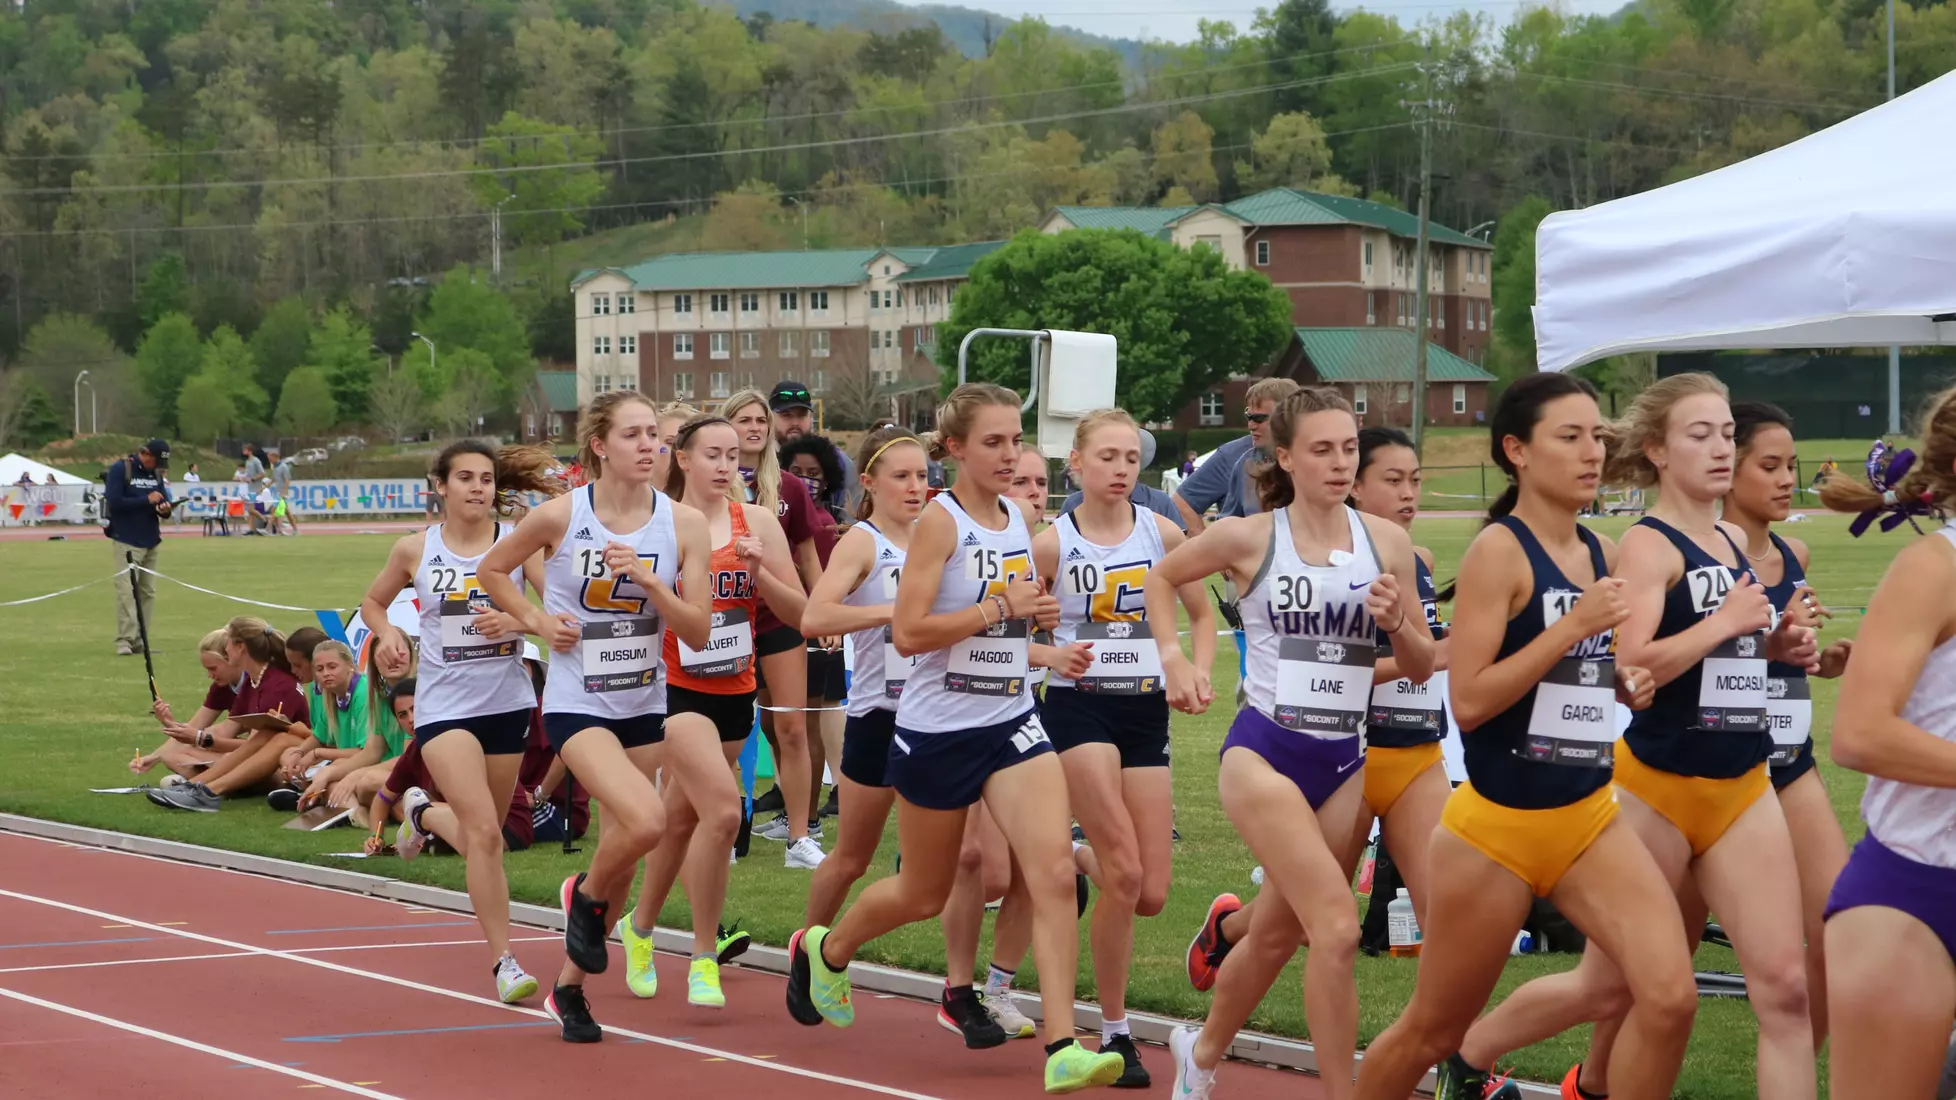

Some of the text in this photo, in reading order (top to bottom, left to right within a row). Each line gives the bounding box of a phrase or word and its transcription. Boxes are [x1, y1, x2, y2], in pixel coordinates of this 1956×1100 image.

[187, 484, 427, 512] CHPION WILL
[580, 548, 606, 579] 13
[973, 548, 999, 580] 15
[431, 568, 458, 594] 22
[1068, 563, 1099, 594] 10
[1695, 568, 1730, 609] 24
[1277, 575, 1313, 611] 30
[600, 647, 647, 662] RUSSUM
[700, 635, 739, 652] ALVERT
[969, 650, 1014, 664] HAGOOD
[1100, 652, 1139, 664] GREEN
[1310, 678, 1344, 695] LANE
[1397, 680, 1428, 696] SMITH
[1562, 704, 1604, 722] GARCIA
